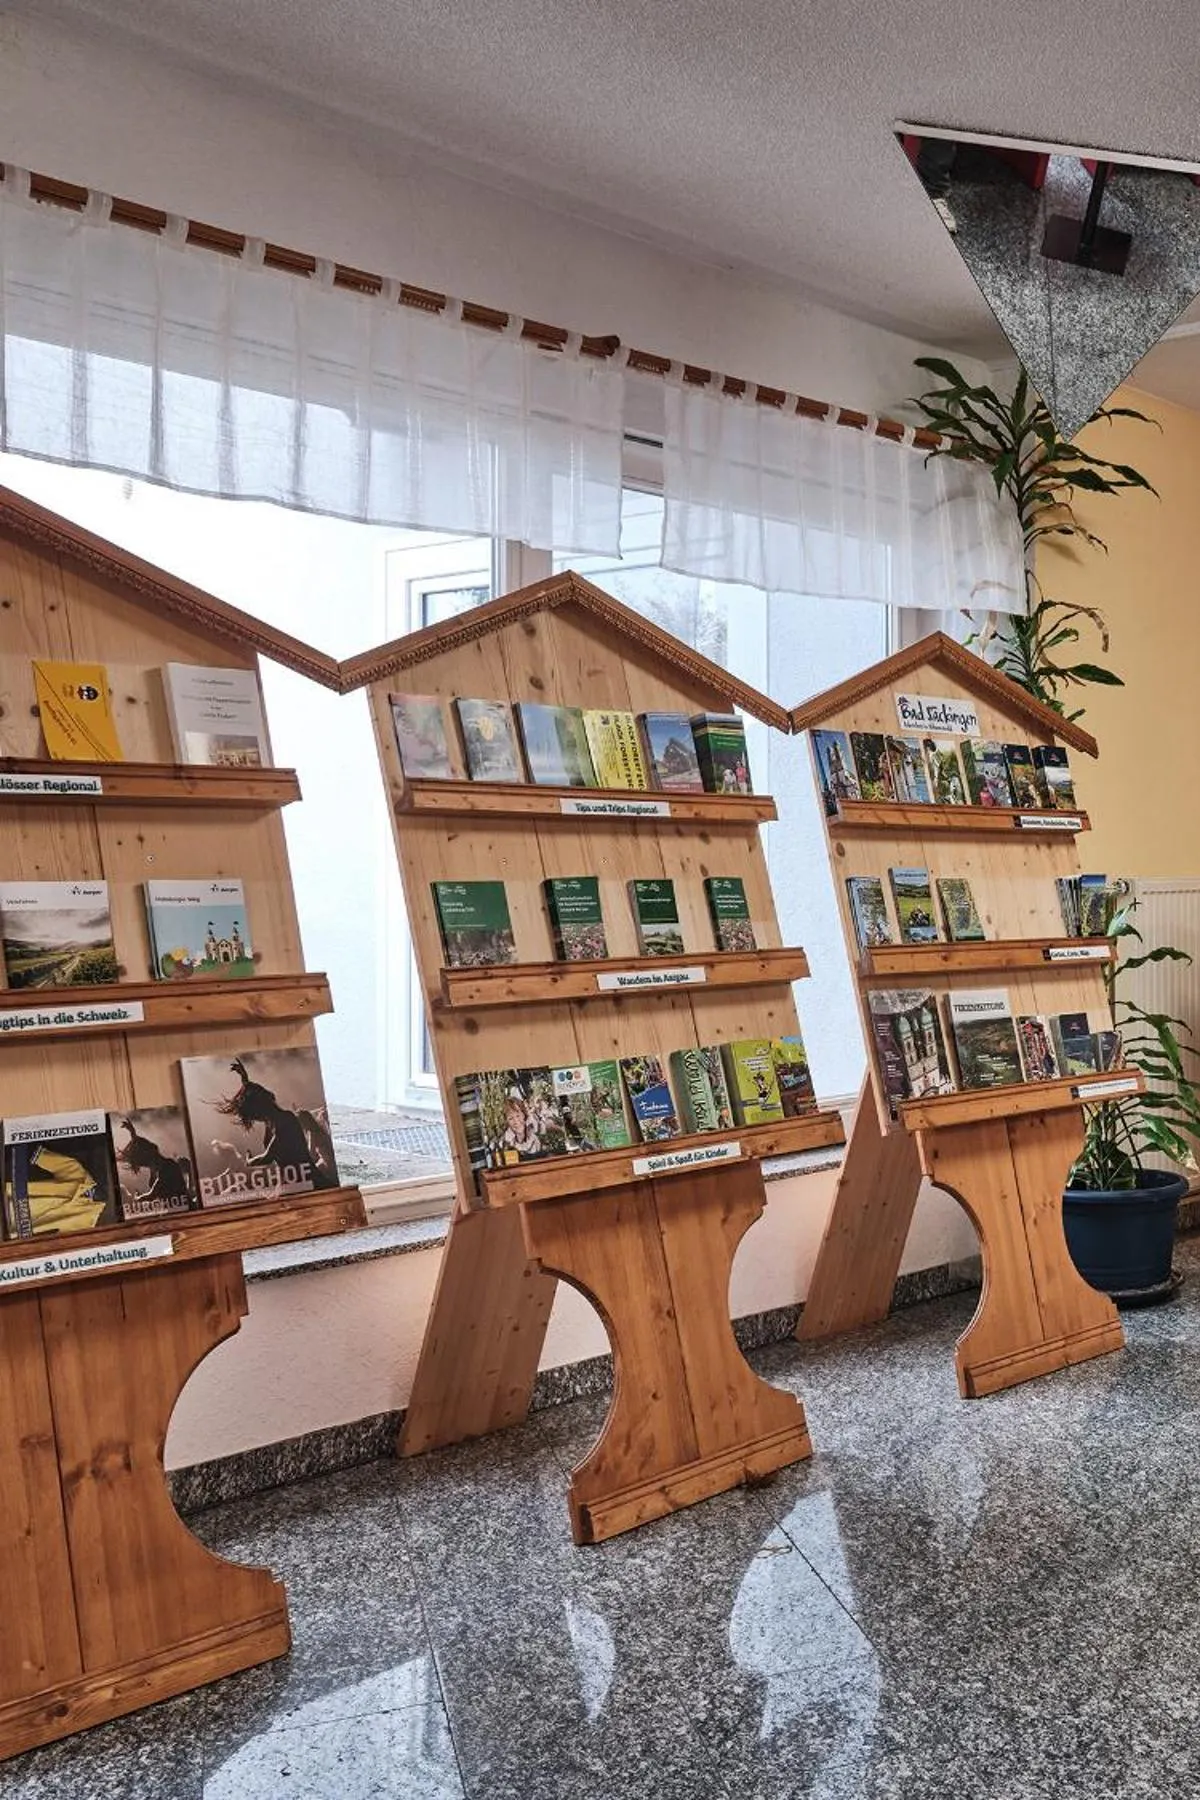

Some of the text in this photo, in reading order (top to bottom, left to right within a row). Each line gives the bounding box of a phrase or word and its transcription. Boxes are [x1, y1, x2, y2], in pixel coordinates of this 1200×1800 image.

[901, 701, 924, 720] Bad
[43, 780, 97, 792] Regional
[617, 975, 651, 986] Wandern
[0, 1008, 128, 1031] gtips in die Schweiz
[11, 1124, 99, 1141] FERIENZEITUNG
[200, 1163, 313, 1197] BURGHOF
[122, 1194, 190, 1215] BURGHOF
[0, 1246, 148, 1281] Kultur & Unterhaltung
